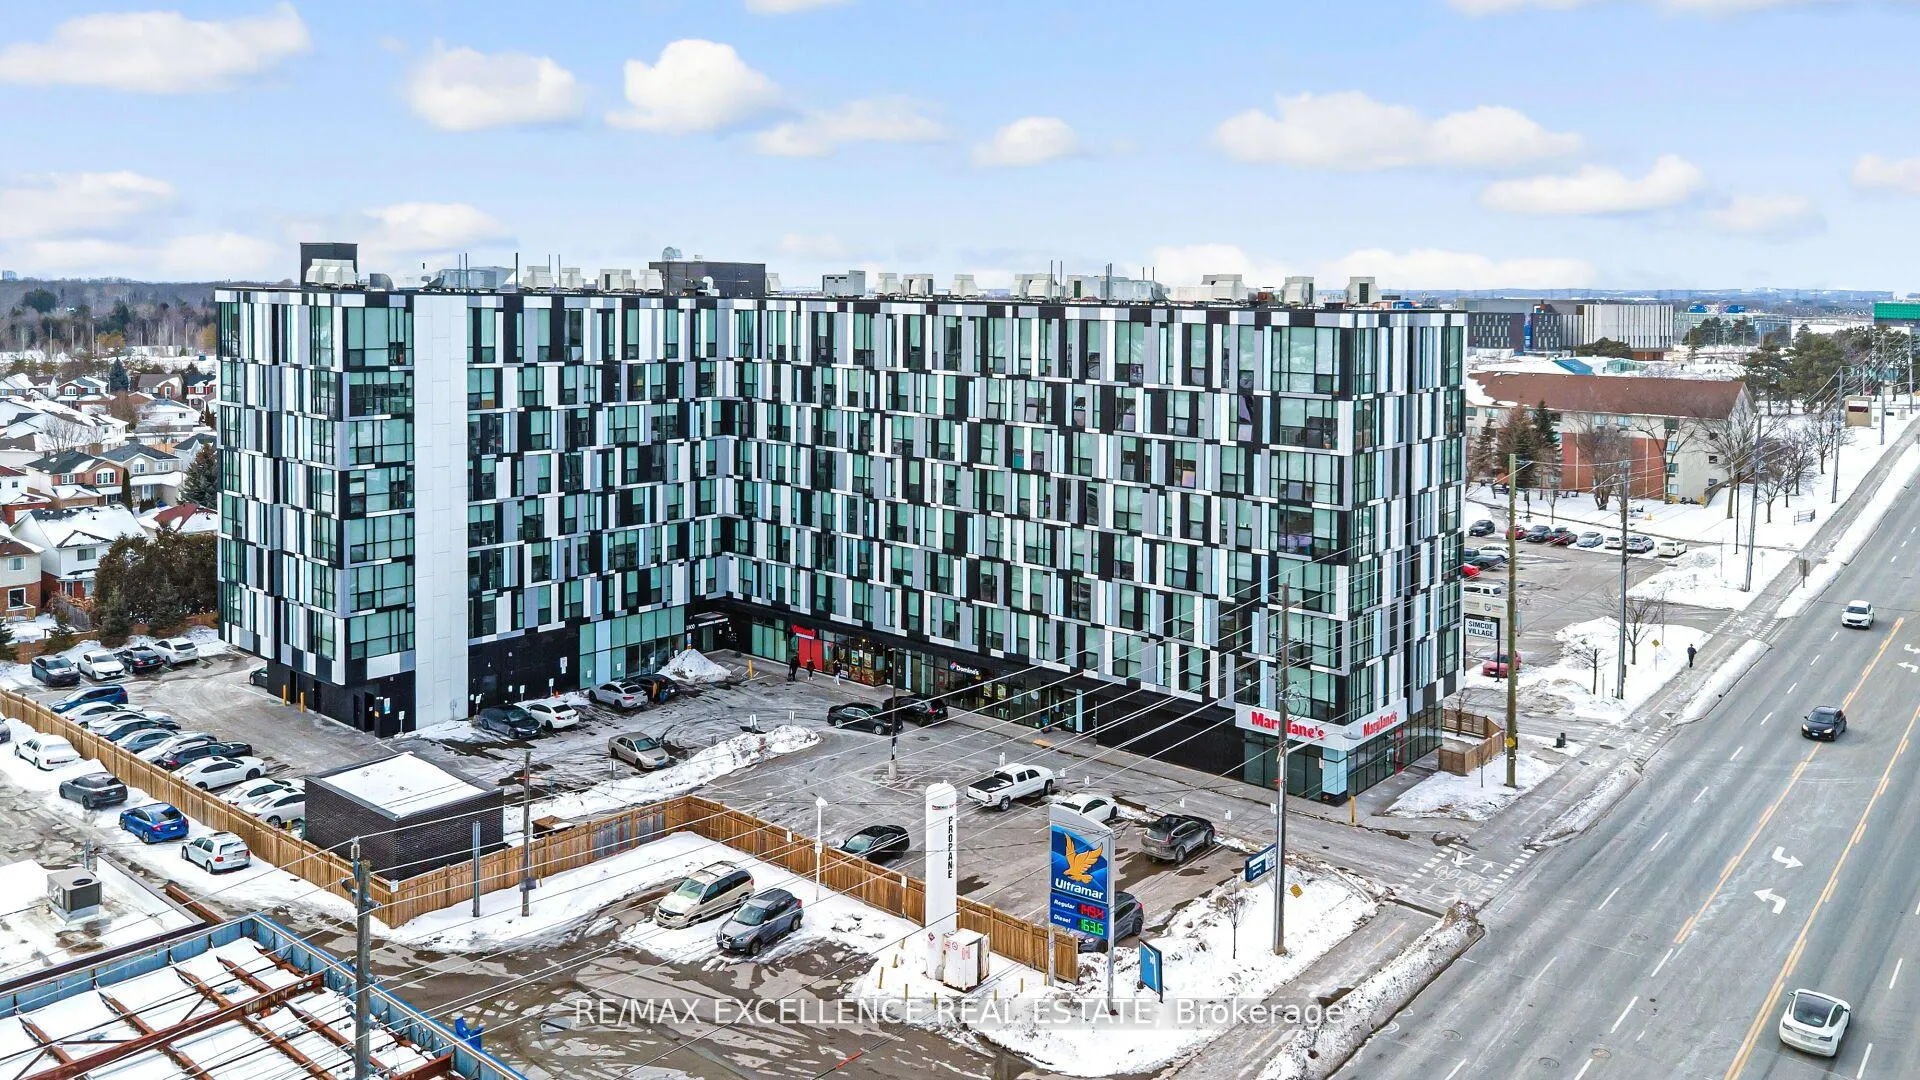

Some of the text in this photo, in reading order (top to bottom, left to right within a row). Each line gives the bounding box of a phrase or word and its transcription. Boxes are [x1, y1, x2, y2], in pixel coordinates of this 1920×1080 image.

[1468, 620, 1494, 630] SIMCOE
[1468, 627, 1494, 637] VILLAGE
[1251, 711, 1325, 741] MarJane's
[1055, 878, 1104, 899] Ultramar
[1053, 899, 1075, 909] Regular
[1053, 914, 1071, 923] Diesel
